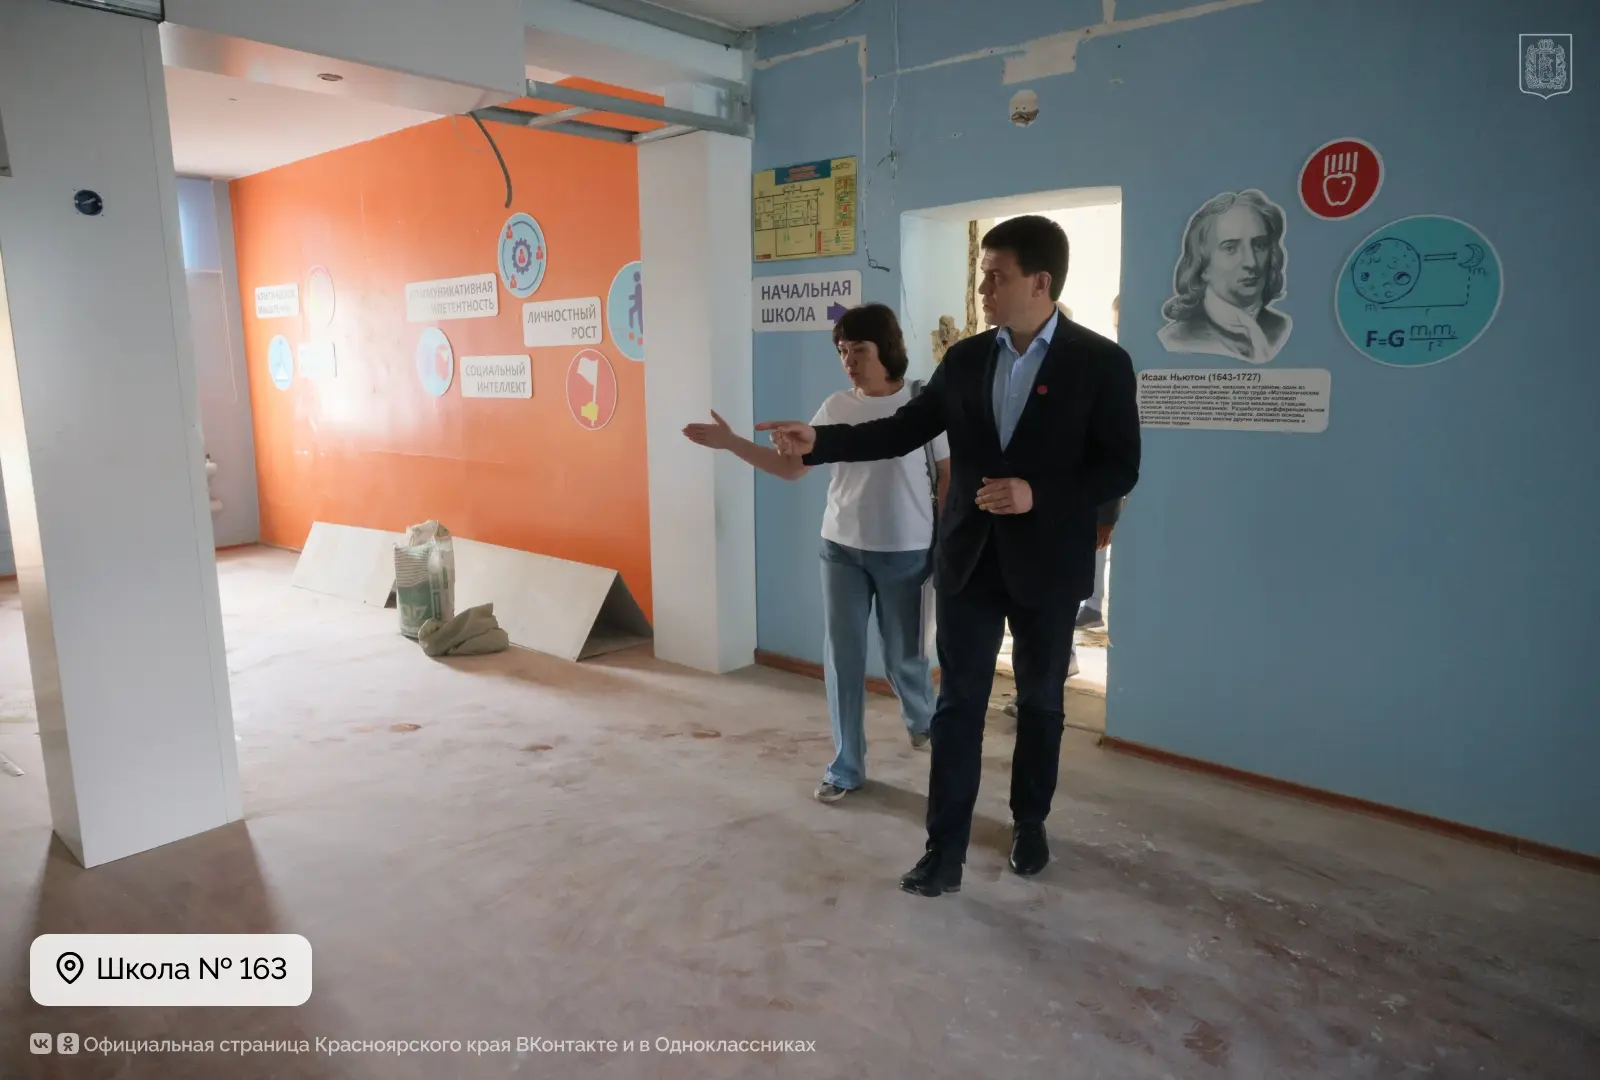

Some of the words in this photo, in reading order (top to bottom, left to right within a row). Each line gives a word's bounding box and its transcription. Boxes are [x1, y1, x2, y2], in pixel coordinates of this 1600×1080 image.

[761, 279, 852, 300] НАЧАЛЬНАЯ
[527, 304, 597, 324] ЛИЧНОСТНЫЙ
[761, 306, 816, 324] ШКОЛА
[571, 326, 598, 340] РОСТ
[465, 362, 526, 378] СОЦИАЛЬНЫЙ
[1141, 373, 1168, 381] Исаак
[1170, 373, 1206, 381] Ньютон
[1208, 373, 1261, 382] (1643-1727)
[477, 381, 528, 395] ИНТЕЛЛЕКТ
